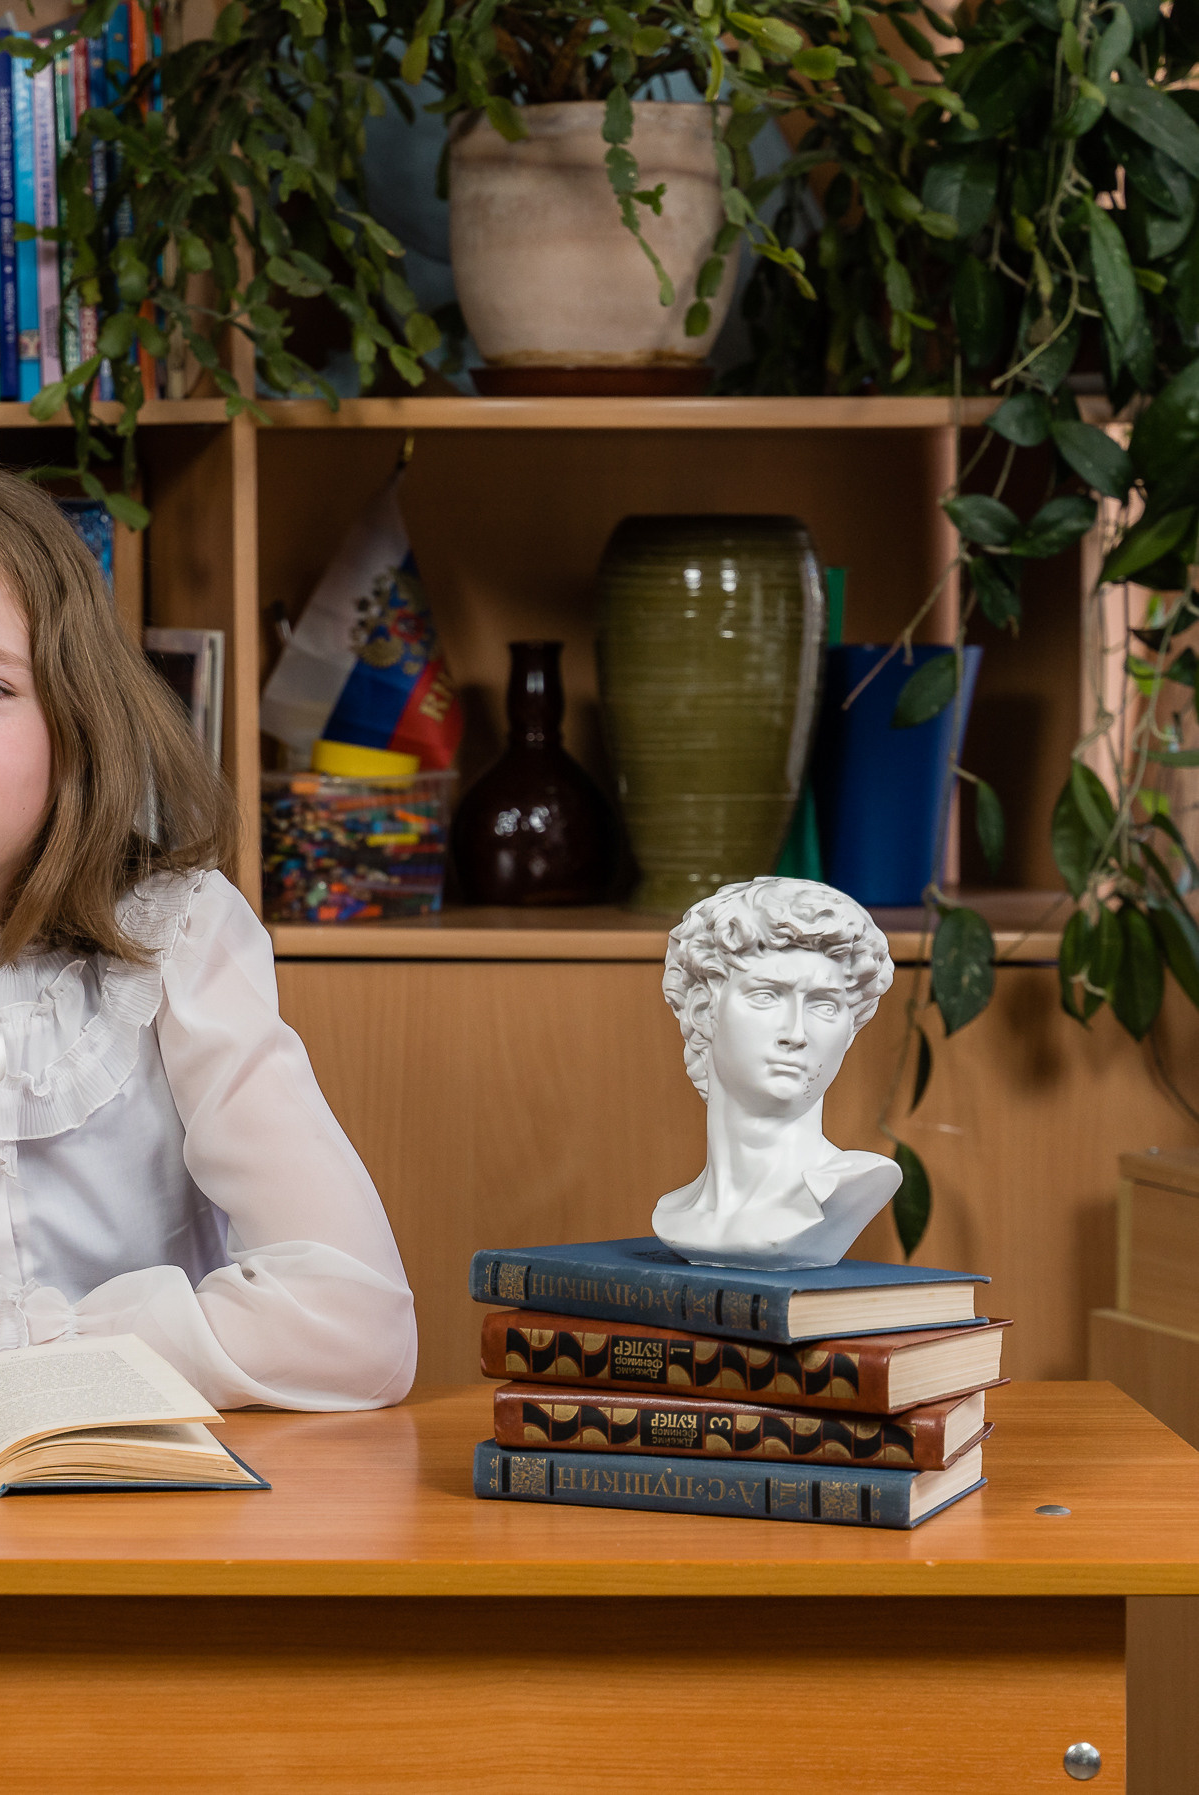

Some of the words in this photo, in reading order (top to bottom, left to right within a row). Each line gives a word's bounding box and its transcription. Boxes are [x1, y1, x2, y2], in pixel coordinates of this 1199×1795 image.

[613, 1340, 663, 1358] КУПЕР
[614, 1356, 664, 1369] Фенимор
[614, 1366, 659, 1379] Джеймс
[650, 1412, 698, 1429] КУПЕР
[709, 1416, 732, 1430] 3
[651, 1427, 698, 1439] Фенимор
[651, 1436, 694, 1448] Джеймс
